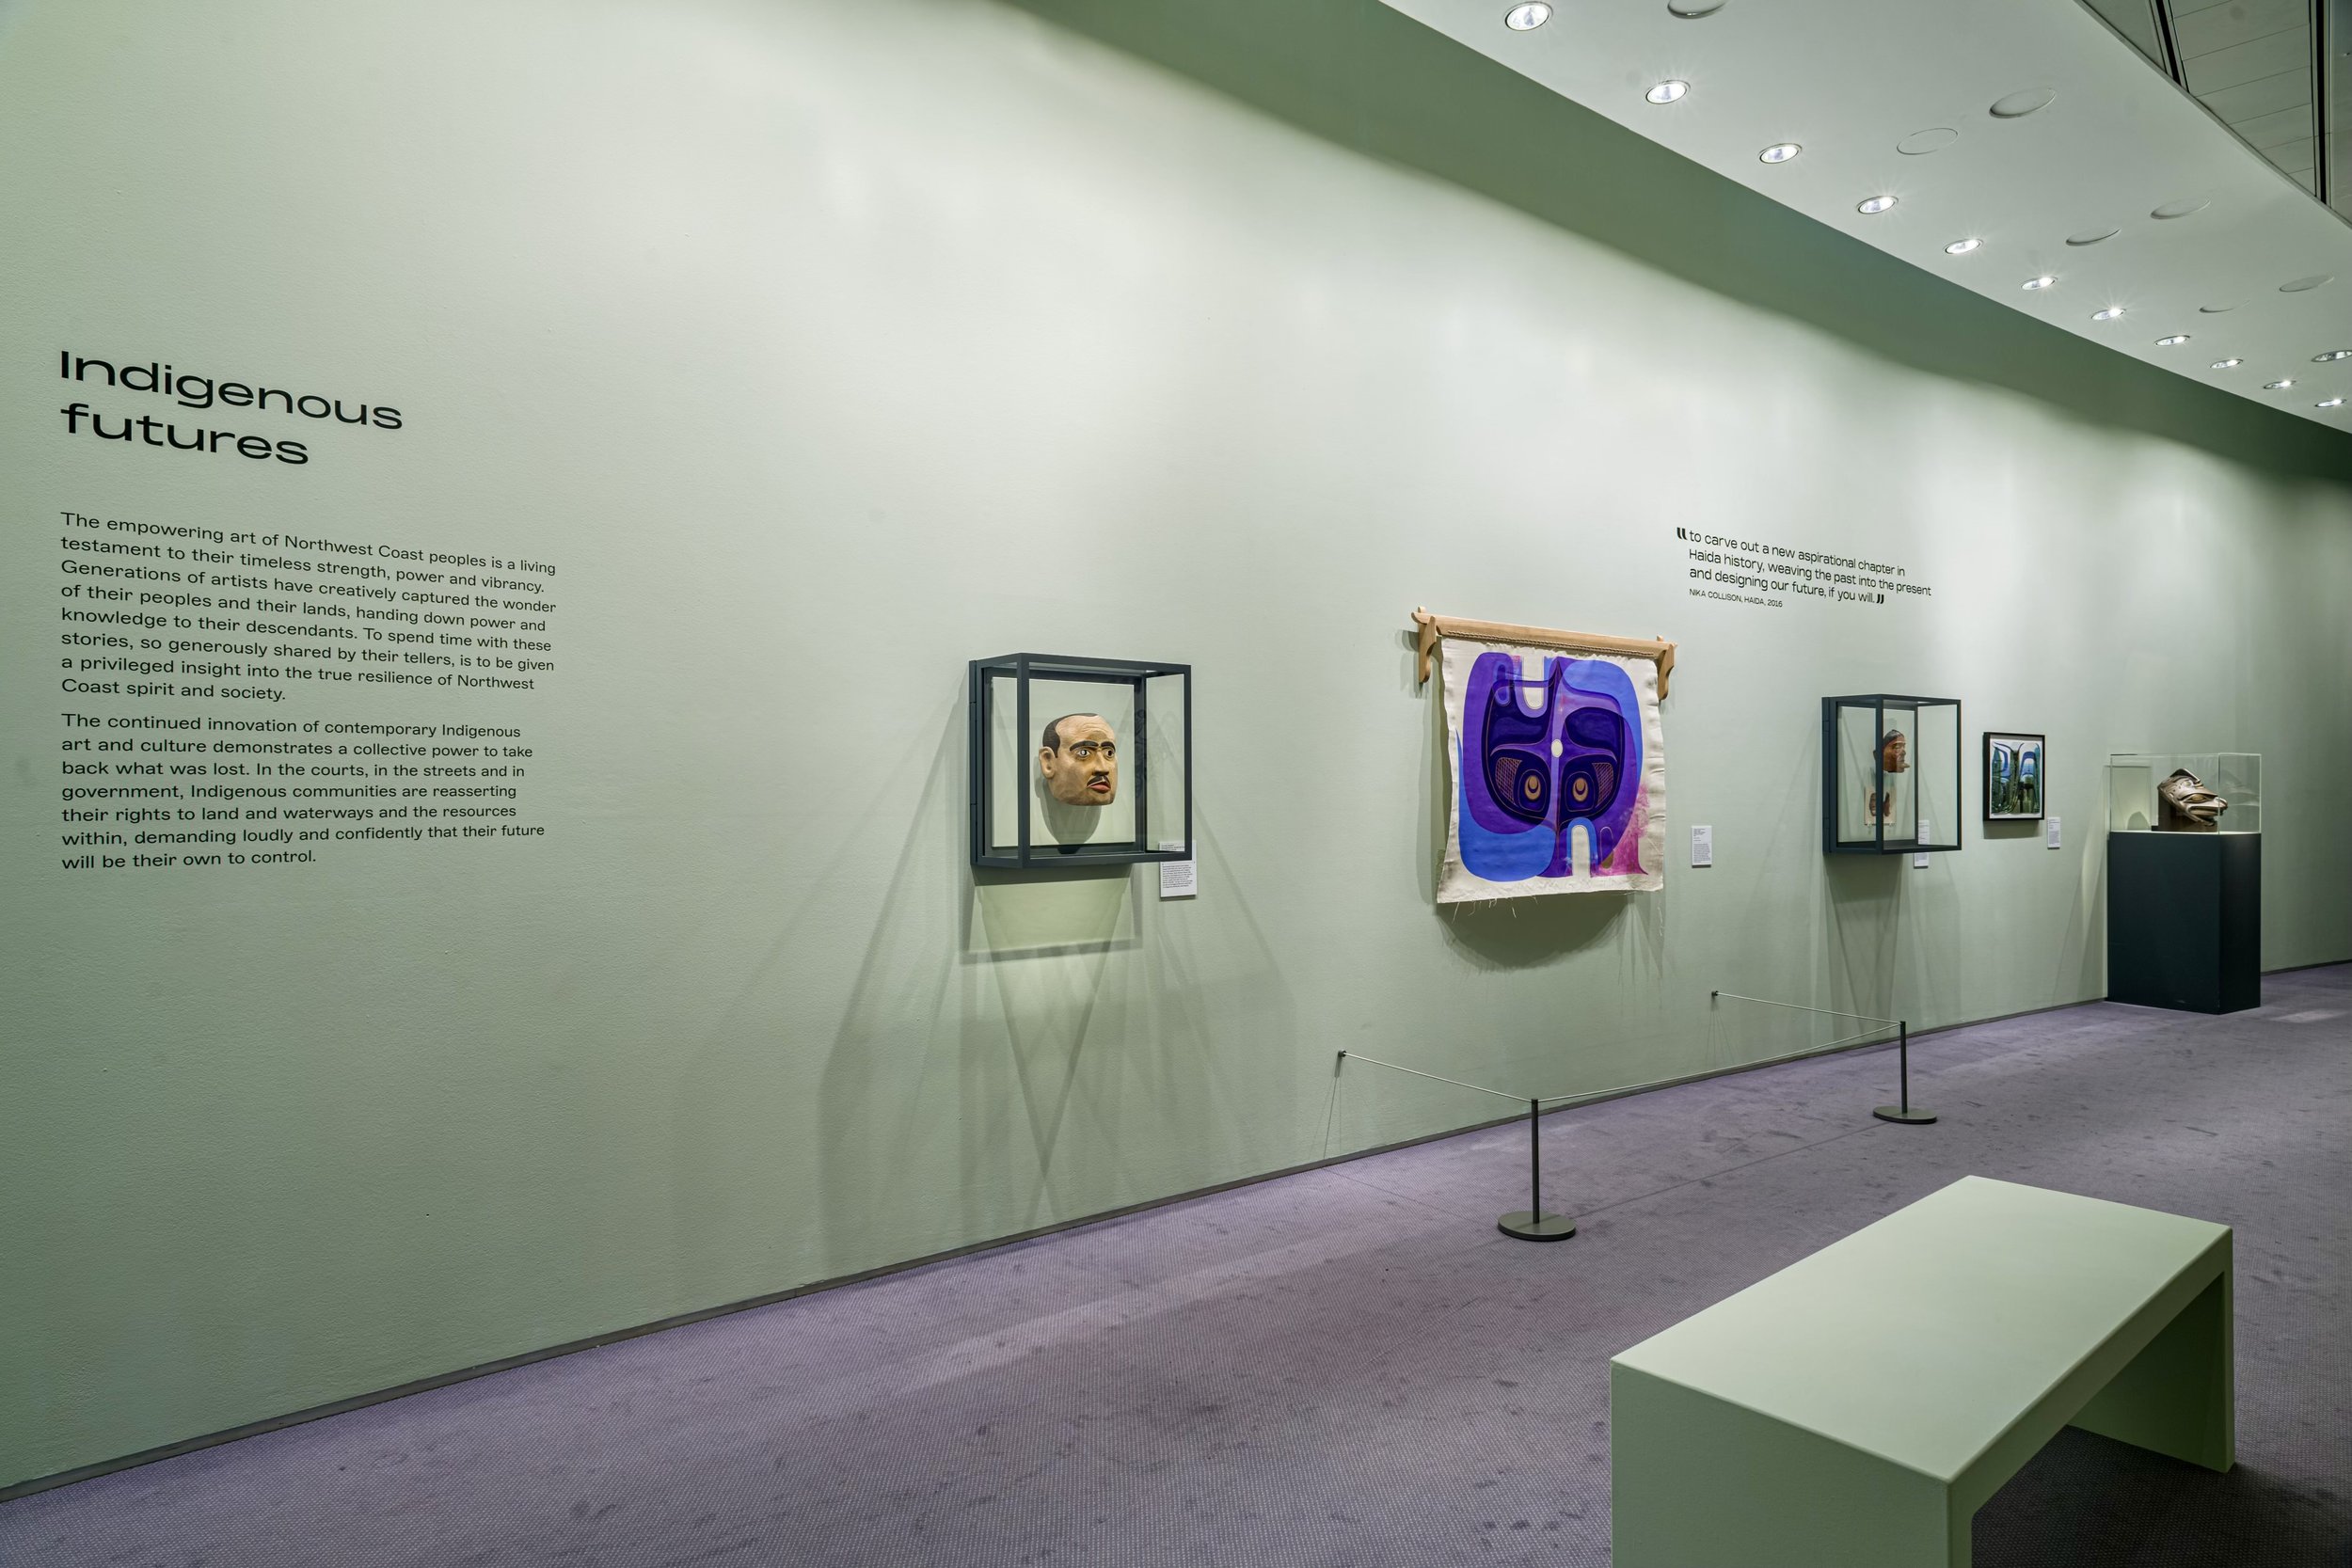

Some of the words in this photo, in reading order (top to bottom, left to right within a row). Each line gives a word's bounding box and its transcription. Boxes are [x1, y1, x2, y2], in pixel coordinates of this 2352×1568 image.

[61, 351, 402, 429] Indigenous
[61, 404, 308, 465] futures
[60, 512, 100, 529] The
[107, 520, 223, 544] empowering
[230, 532, 256, 544] art
[262, 534, 279, 546] of
[285, 535, 373, 556] Northwest
[379, 546, 423, 561] Coast
[430, 553, 486, 566] peoples
[492, 557, 502, 568] is
[521, 560, 555, 576] living
[1704, 534, 1739, 549] carve
[1740, 541, 1760, 553] out
[1761, 545, 1770, 555] a
[1772, 546, 1796, 559] new
[1798, 550, 1856, 569] aspirational
[1857, 560, 1896, 576] chapter
[1897, 567, 1906, 577] in
[60, 537, 161, 557] testament
[167, 546, 185, 560] to
[192, 549, 234, 563] their
[240, 554, 310, 571] timeless
[317, 562, 389, 580] strength,
[397, 571, 444, 582] power
[450, 575, 476, 586] and
[482, 577, 544, 594] vibrancy.
[1689, 548, 1722, 564] Haida
[1724, 553, 1765, 574] history,
[1767, 562, 1813, 581] weaving
[1814, 568, 1832, 581] the
[1834, 573, 1857, 585] past
[1858, 577, 1877, 588] into
[1878, 578, 1895, 591] the
[1896, 582, 1932, 596] present
[61, 560, 181, 582] Generations
[188, 572, 205, 584] of
[212, 575, 267, 589] artists
[275, 578, 312, 593] have
[319, 585, 396, 602] creatively
[402, 592, 469, 605] captured
[475, 595, 498, 608] the
[503, 600, 556, 612] wonder
[1689, 568, 1712, 580] and
[1714, 570, 1769, 592] designing
[1770, 580, 1789, 592] our
[1791, 580, 1827, 598] future,
[1828, 586, 1836, 598] if
[1836, 590, 1856, 602] you
[1689, 588, 1707, 597] NIKA
[1767, 598, 1784, 608] 2016
[61, 585, 81, 597] of
[87, 586, 133, 601] their
[140, 593, 212, 607] peoples
[218, 598, 249, 610] and
[257, 599, 296, 612] their
[304, 602, 350, 619] lands,
[357, 606, 418, 625] handing
[424, 612, 464, 626] down
[470, 618, 516, 628] power
[520, 621, 545, 631] and
[62, 608, 167, 628] knowledge
[173, 616, 191, 628] to
[198, 617, 240, 631] their
[246, 620, 358, 639] descendants.
[363, 627, 382, 641] To
[389, 632, 434, 644] spend
[439, 633, 471, 646] time
[477, 637, 507, 648] with
[513, 639, 551, 651] these
[62, 633, 133, 650] stories,
[141, 639, 162, 649] so
[168, 641, 267, 657] generously
[274, 644, 331, 658] shared
[339, 647, 356, 662] by
[361, 649, 399, 662] their
[404, 652, 454, 667] tellers,
[460, 655, 471, 666] is
[476, 657, 490, 667] to
[497, 657, 513, 669] be
[518, 658, 553, 672] given
[62, 658, 72, 668] a
[81, 657, 173, 674] privileged
[182, 661, 241, 677] insight
[247, 664, 279, 677] into
[285, 667, 312, 679] the
[318, 669, 352, 681] true
[358, 672, 432, 685] resilience
[437, 674, 453, 685] of
[458, 674, 534, 689] Northwest
[62, 679, 119, 693] Coast
[127, 682, 175, 697] spirit
[182, 685, 214, 697] and
[221, 687, 285, 702] society.
[61, 714, 100, 727] The
[108, 716, 200, 729] continued
[209, 718, 296, 732] innovation
[303, 721, 320, 732] of
[325, 722, 437, 737] contemporary
[443, 724, 520, 738] Indigenous
[62, 738, 91, 751] art
[99, 738, 133, 751] and
[141, 739, 206, 752] culture
[214, 740, 332, 754] demonstrates
[339, 746, 347, 754] a
[354, 743, 426, 755] collective
[433, 748, 479, 758] power
[484, 746, 498, 756] to
[502, 746, 532, 757] take
[62, 761, 108, 774] back
[116, 762, 164, 774] what
[169, 766, 207, 775] was
[215, 763, 249, 775] lost.
[257, 763, 271, 775] In
[278, 764, 305, 775] the
[311, 765, 368, 778] courts,
[374, 765, 387, 776] in
[393, 765, 418, 776] the
[423, 766, 476, 776] streets
[482, 766, 507, 776] and
[513, 766, 524, 776] in
[62, 785, 183, 800] government,
[192, 785, 286, 800] Indigenous
[293, 785, 396, 797] communities
[403, 788, 427, 797] are
[434, 785, 516, 799] reasserting
[61, 808, 108, 821] their
[117, 808, 170, 824] rights
[177, 809, 195, 820] to
[202, 807, 238, 820] land
[246, 807, 277, 819] and
[283, 808, 373, 820] waterways
[379, 806, 406, 817] and
[413, 806, 437, 817] the
[443, 808, 516, 816] resources
[62, 832, 127, 847] within,
[135, 830, 235, 845] demanding
[244, 829, 293, 843] loudly
[299, 829, 328, 840] and
[336, 827, 422, 840] confidently
[427, 827, 457, 837] that
[463, 825, 497, 837] their
[501, 825, 544, 836] future
[62, 856, 94, 869] will
[103, 855, 125, 867] be
[133, 853, 177, 866] their
[183, 855, 221, 865] own
[228, 853, 245, 863] to
[251, 850, 316, 863] control.
